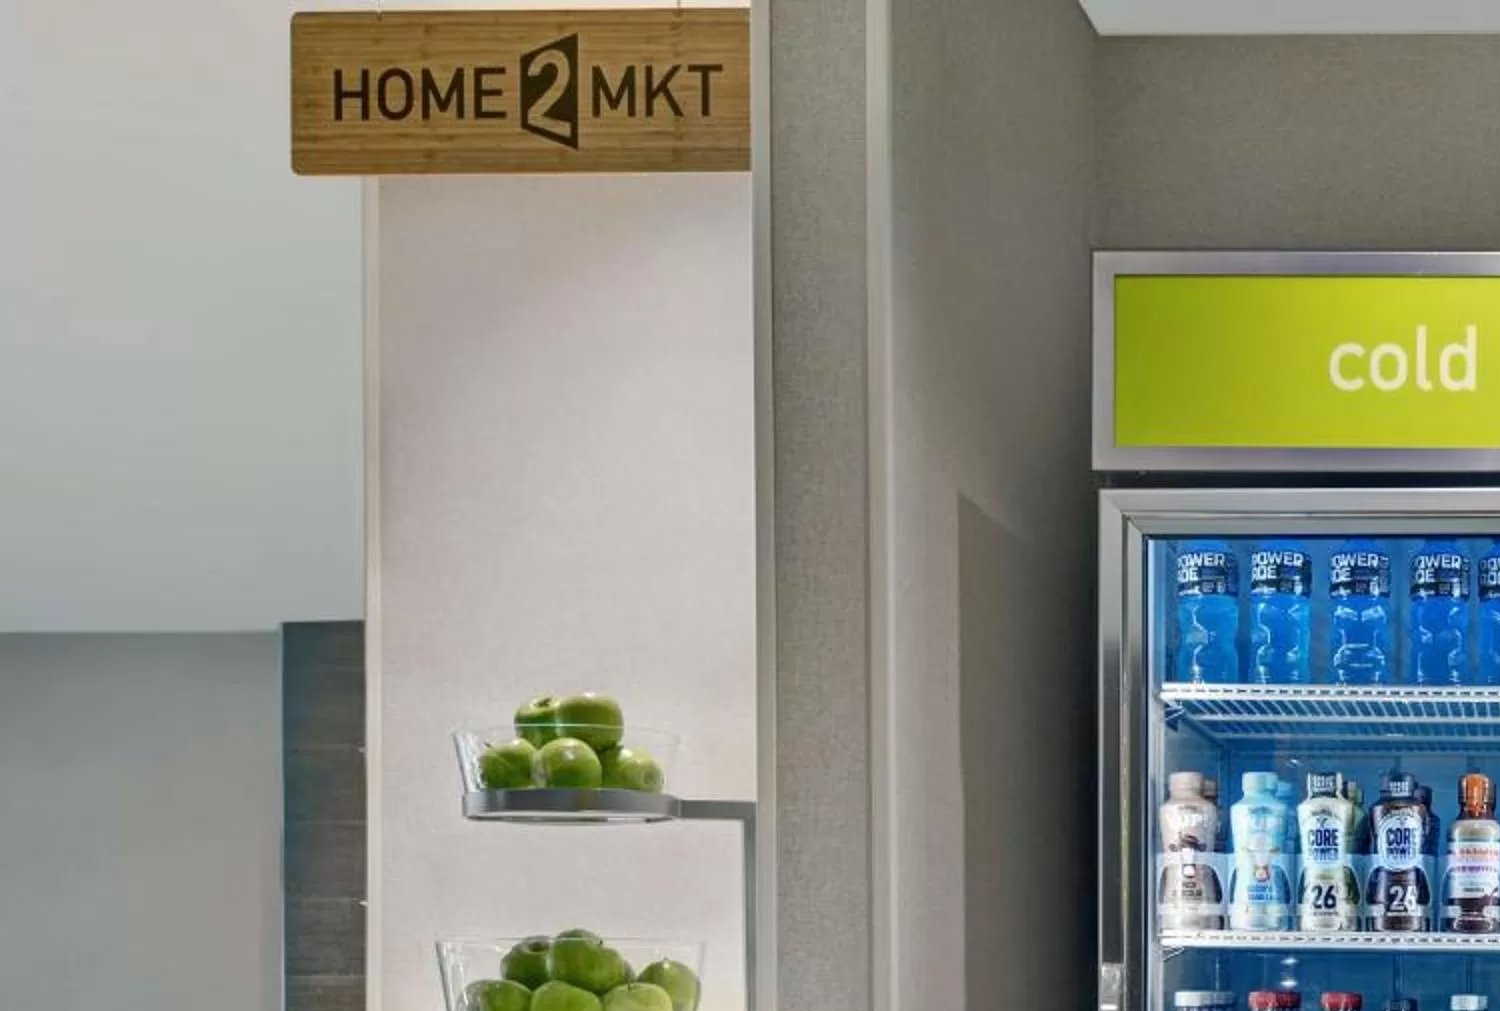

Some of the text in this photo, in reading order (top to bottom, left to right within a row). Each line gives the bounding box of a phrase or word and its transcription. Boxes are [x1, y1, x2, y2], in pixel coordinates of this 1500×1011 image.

[1329, 323, 1478, 391] cold
[1308, 829, 1339, 847] CORE
[1313, 886, 1337, 909] 26
